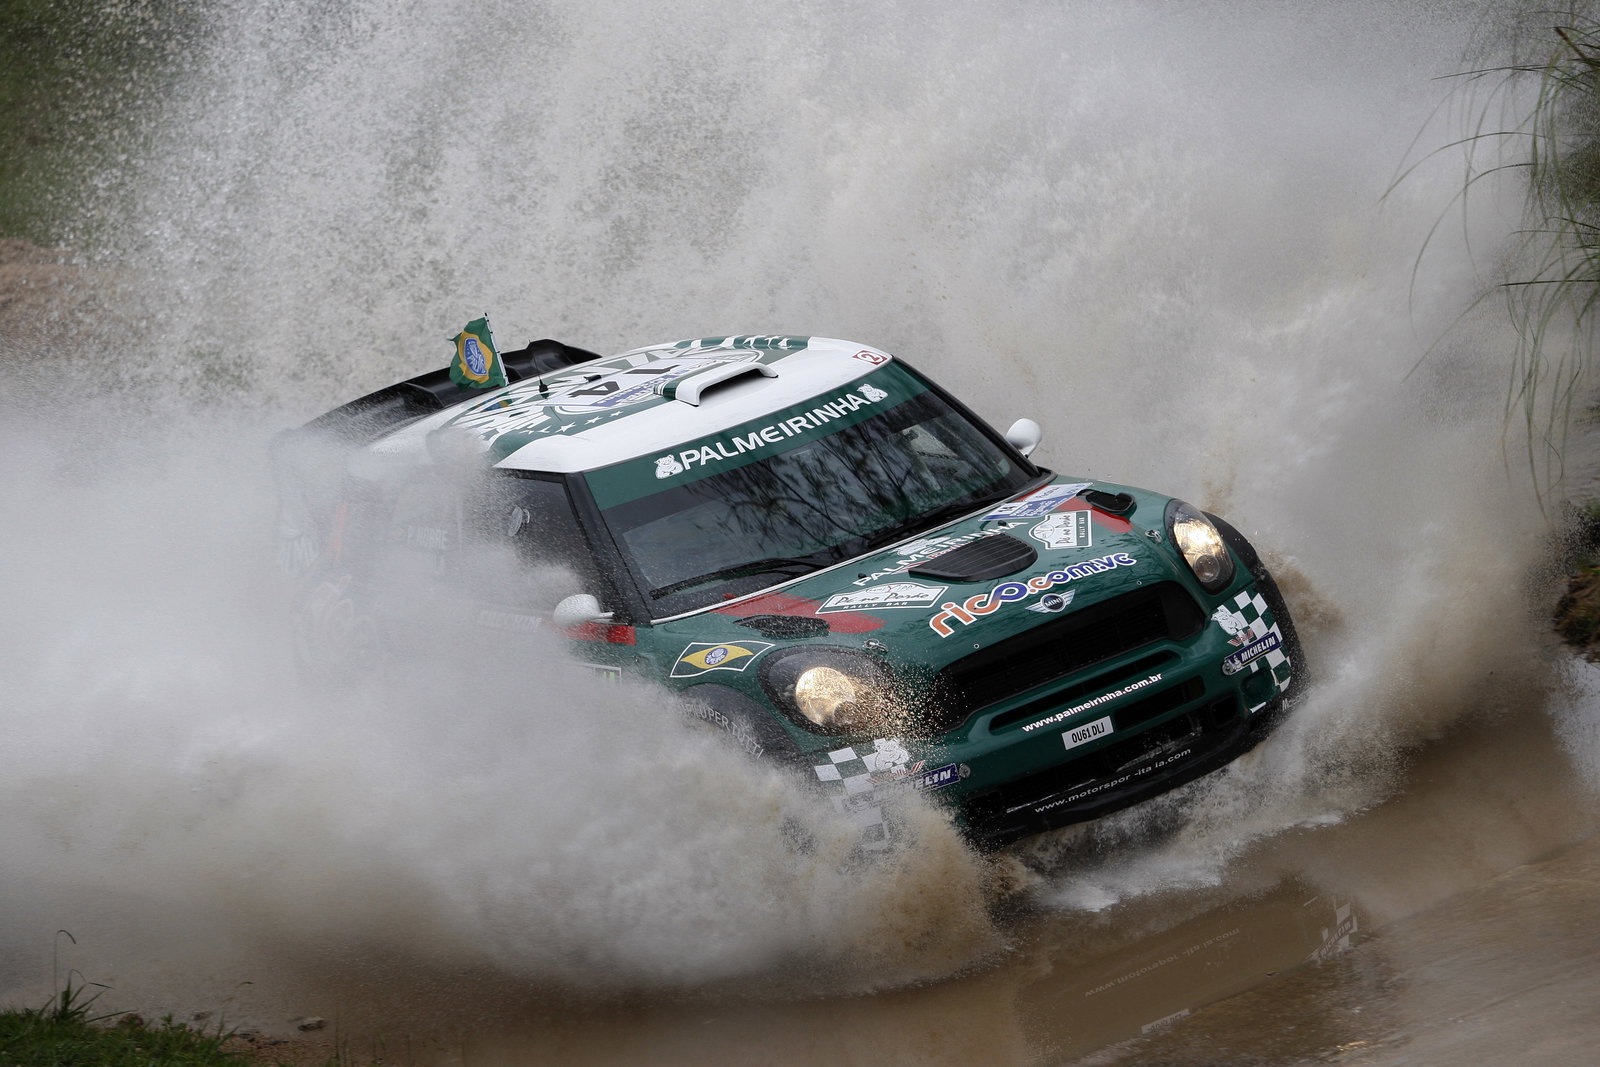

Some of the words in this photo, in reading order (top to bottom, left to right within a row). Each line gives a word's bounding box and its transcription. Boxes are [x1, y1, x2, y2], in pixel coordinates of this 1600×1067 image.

[679, 393, 872, 471] PALMEIRINHA
[852, 521, 1030, 587] PALMEIRINHA
[1045, 597, 1062, 607] MINI
[1241, 635, 1276, 662] MICHELIN
[1022, 672, 1163, 732] www.palmeirinha.com.br
[1091, 722, 1105, 736] DLJ
